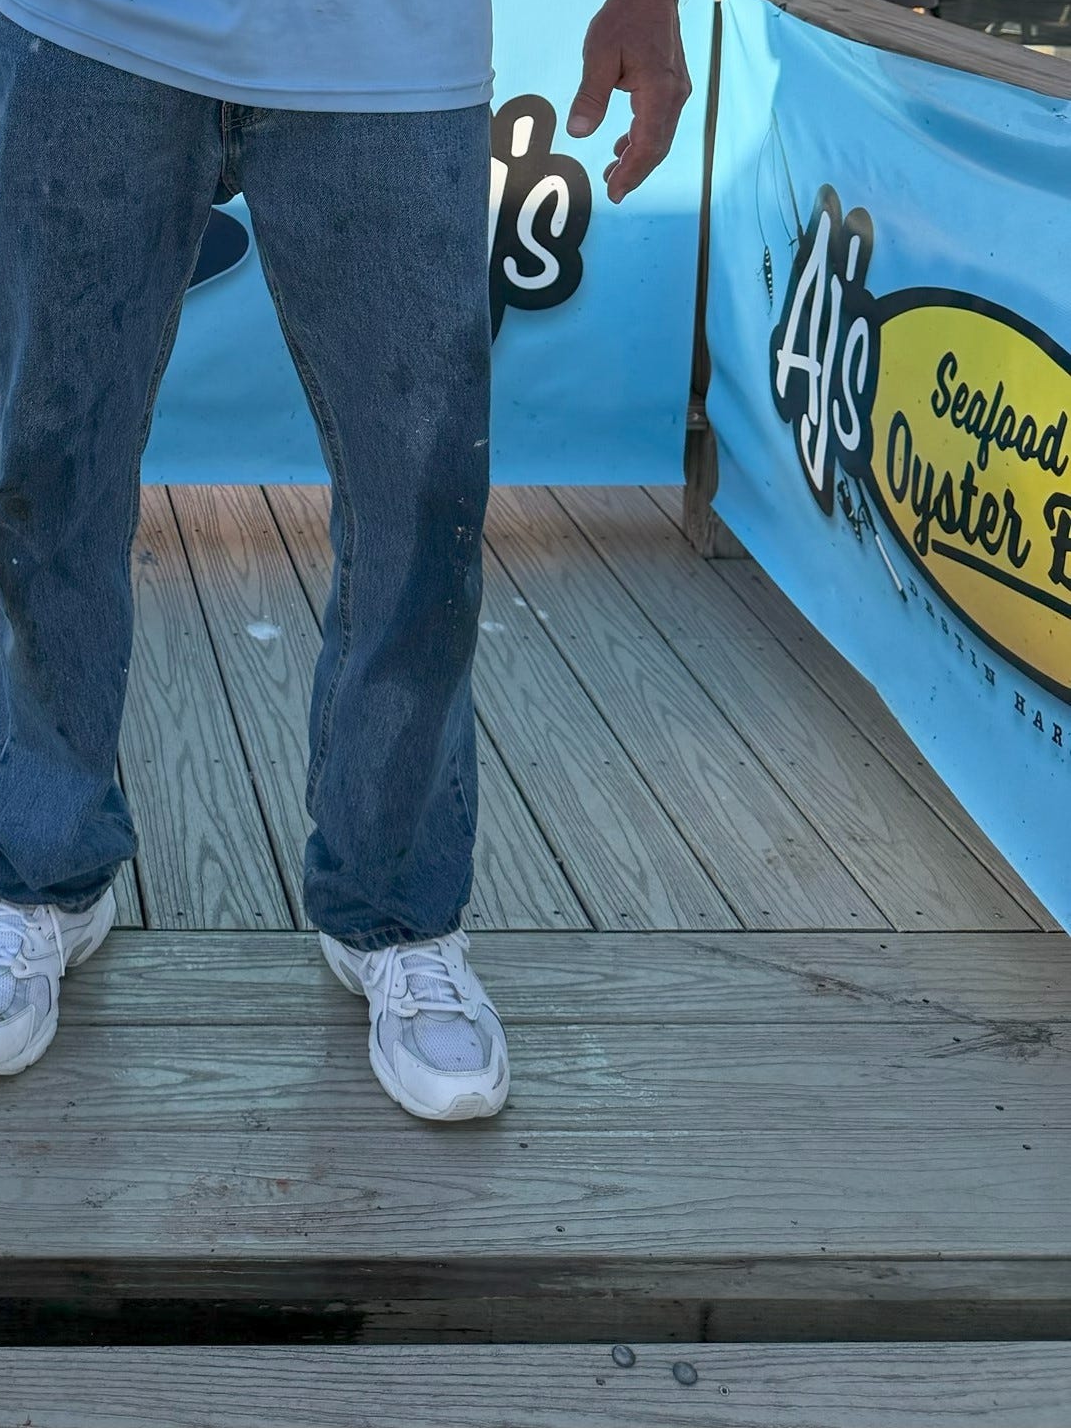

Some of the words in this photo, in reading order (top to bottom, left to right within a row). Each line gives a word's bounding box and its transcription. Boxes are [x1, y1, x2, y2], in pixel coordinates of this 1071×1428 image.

[931, 351, 1069, 477] Seafood
[886, 410, 1031, 569] Oyster
[1014, 690, 1071, 757] HAR
